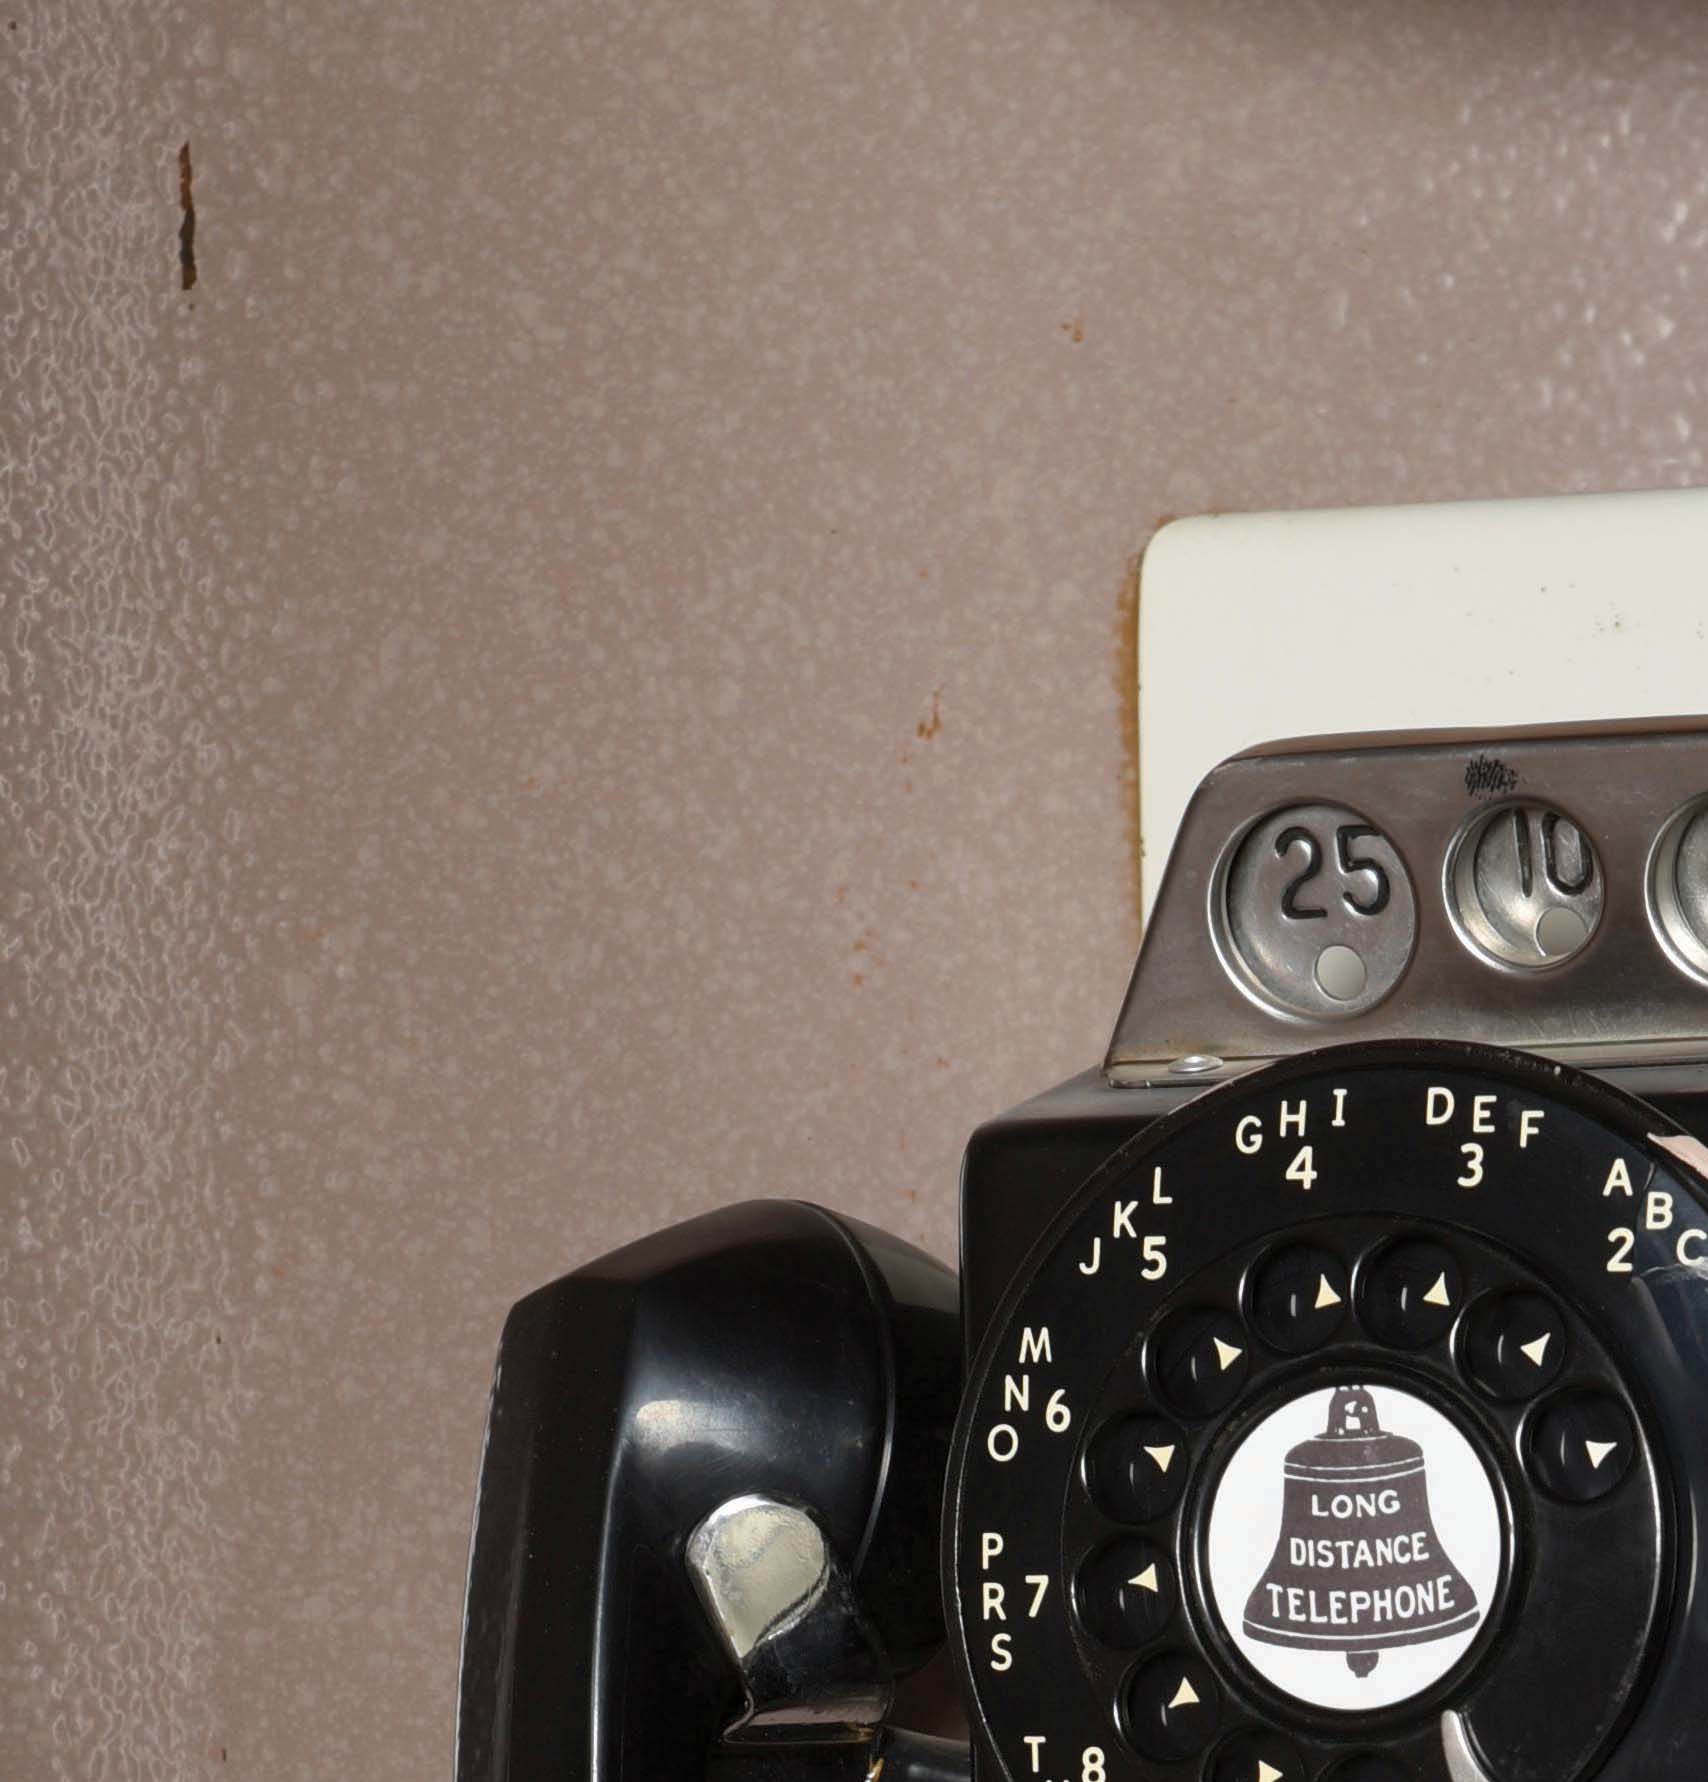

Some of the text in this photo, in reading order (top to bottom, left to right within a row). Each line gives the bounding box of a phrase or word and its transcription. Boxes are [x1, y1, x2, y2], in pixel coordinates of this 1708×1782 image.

[1274, 826, 1392, 916] 25
[1512, 807, 1594, 898] 10
[1285, 1145, 1318, 1190] 4
[1456, 1142, 1484, 1188] 3
[1140, 1235, 1167, 1281] 5
[1606, 1227, 1635, 1272] 2
[1045, 1388, 1071, 1433] 6
[1310, 1489, 1401, 1519] LONG
[1289, 1531, 1430, 1570] DISTANCE
[1025, 1574, 1050, 1618] 7
[1265, 1574, 1456, 1625] TELEPHONE
